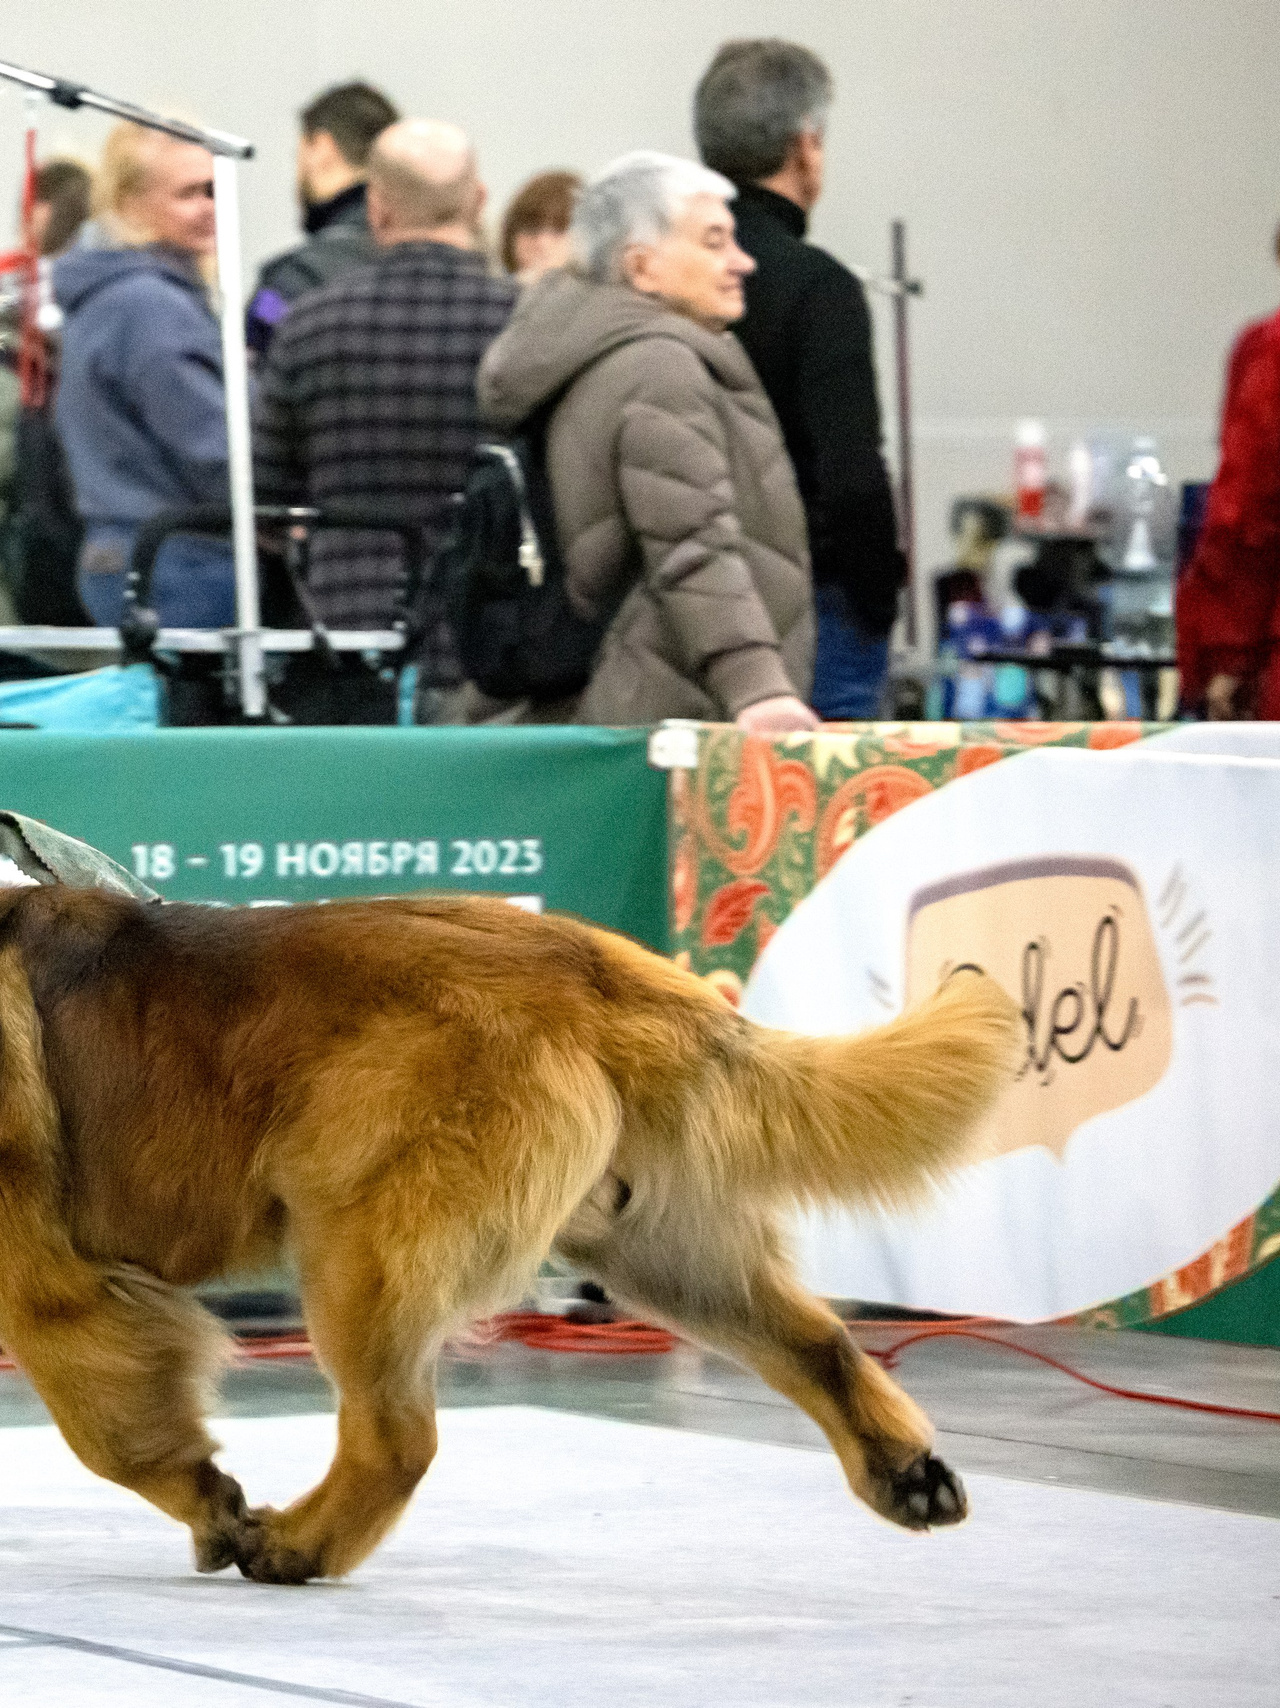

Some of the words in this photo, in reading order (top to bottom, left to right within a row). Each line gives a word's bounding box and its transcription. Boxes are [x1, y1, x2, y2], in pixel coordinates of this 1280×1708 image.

[131, 843, 175, 880] 18
[220, 843, 264, 878] 19
[275, 841, 439, 877] НОЯБРЯ
[450, 839, 543, 875] 2023
[938, 915, 1140, 1073] del
